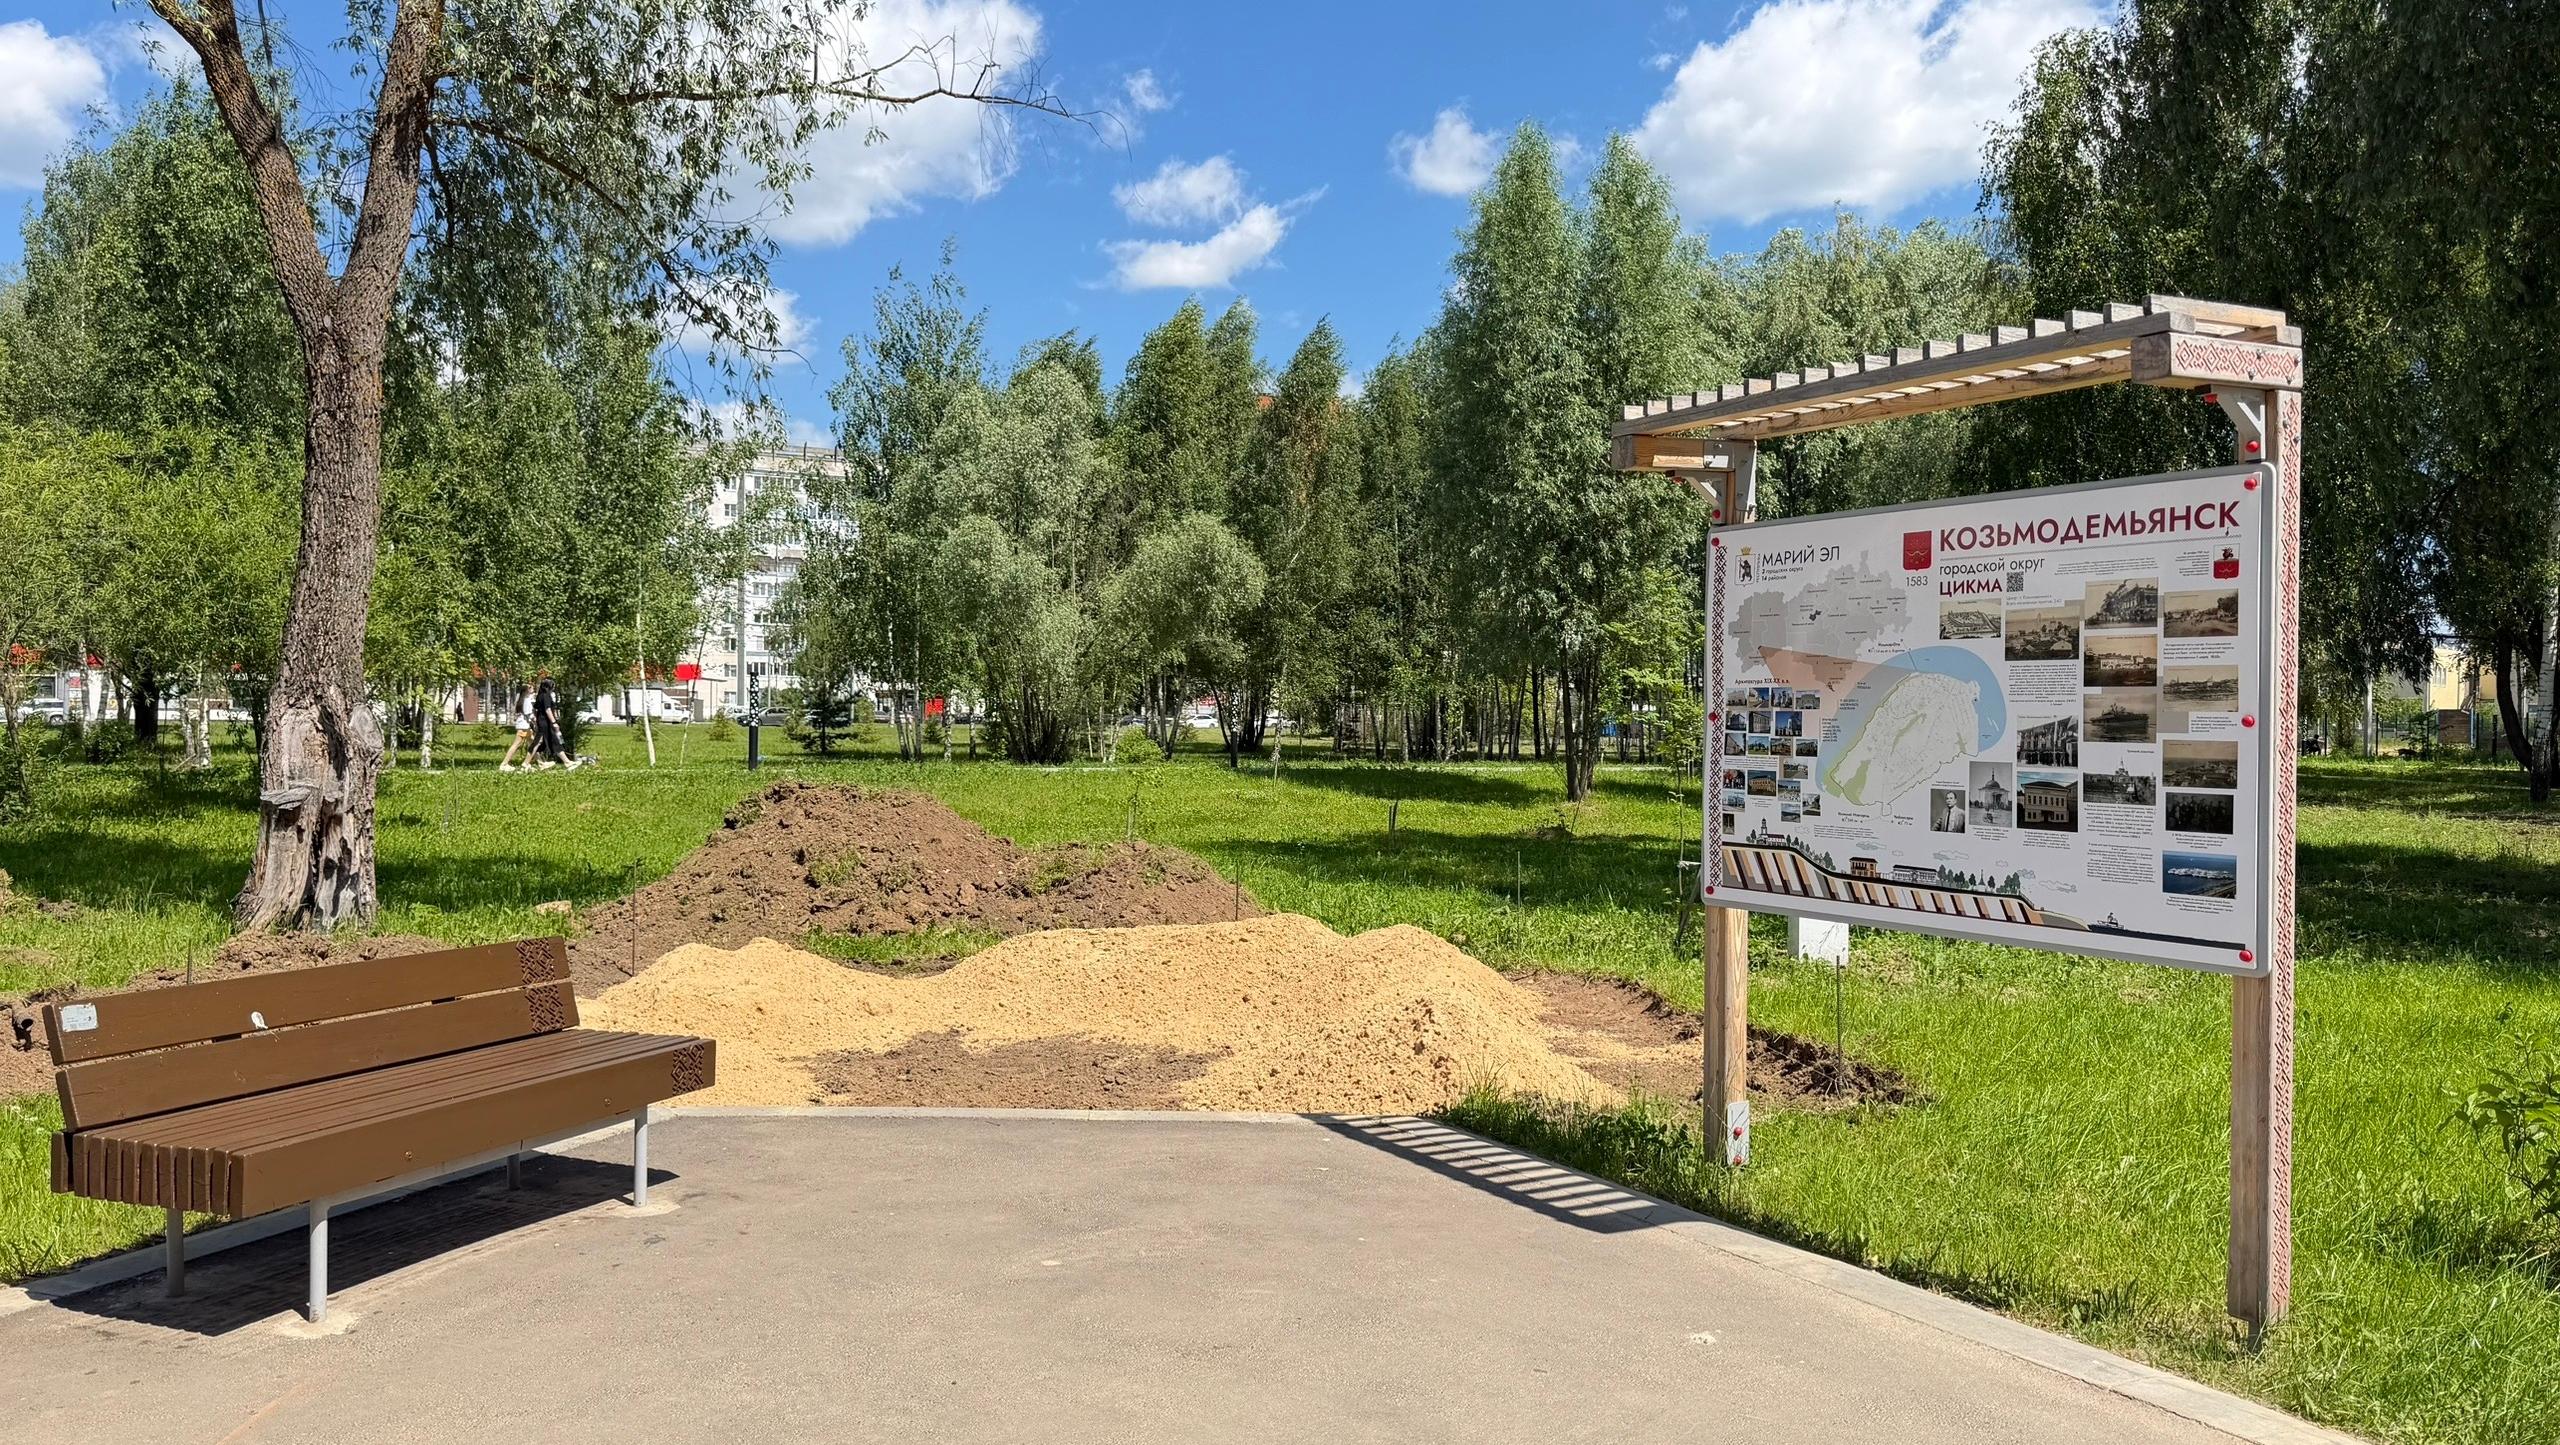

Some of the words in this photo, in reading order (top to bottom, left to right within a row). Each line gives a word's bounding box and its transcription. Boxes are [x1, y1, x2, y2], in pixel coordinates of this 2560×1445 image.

[1940, 501, 2240, 551] КОЗЬМОДЕМЬЯНСК
[1762, 545, 1815, 567] МАРИЙ
[1820, 546, 1840, 562] ЭЛ
[1940, 557, 2005, 576] городской
[2009, 557, 2046, 574] округ
[1905, 576, 1929, 587] 1583
[1940, 577, 2003, 597] ЦИКМА
